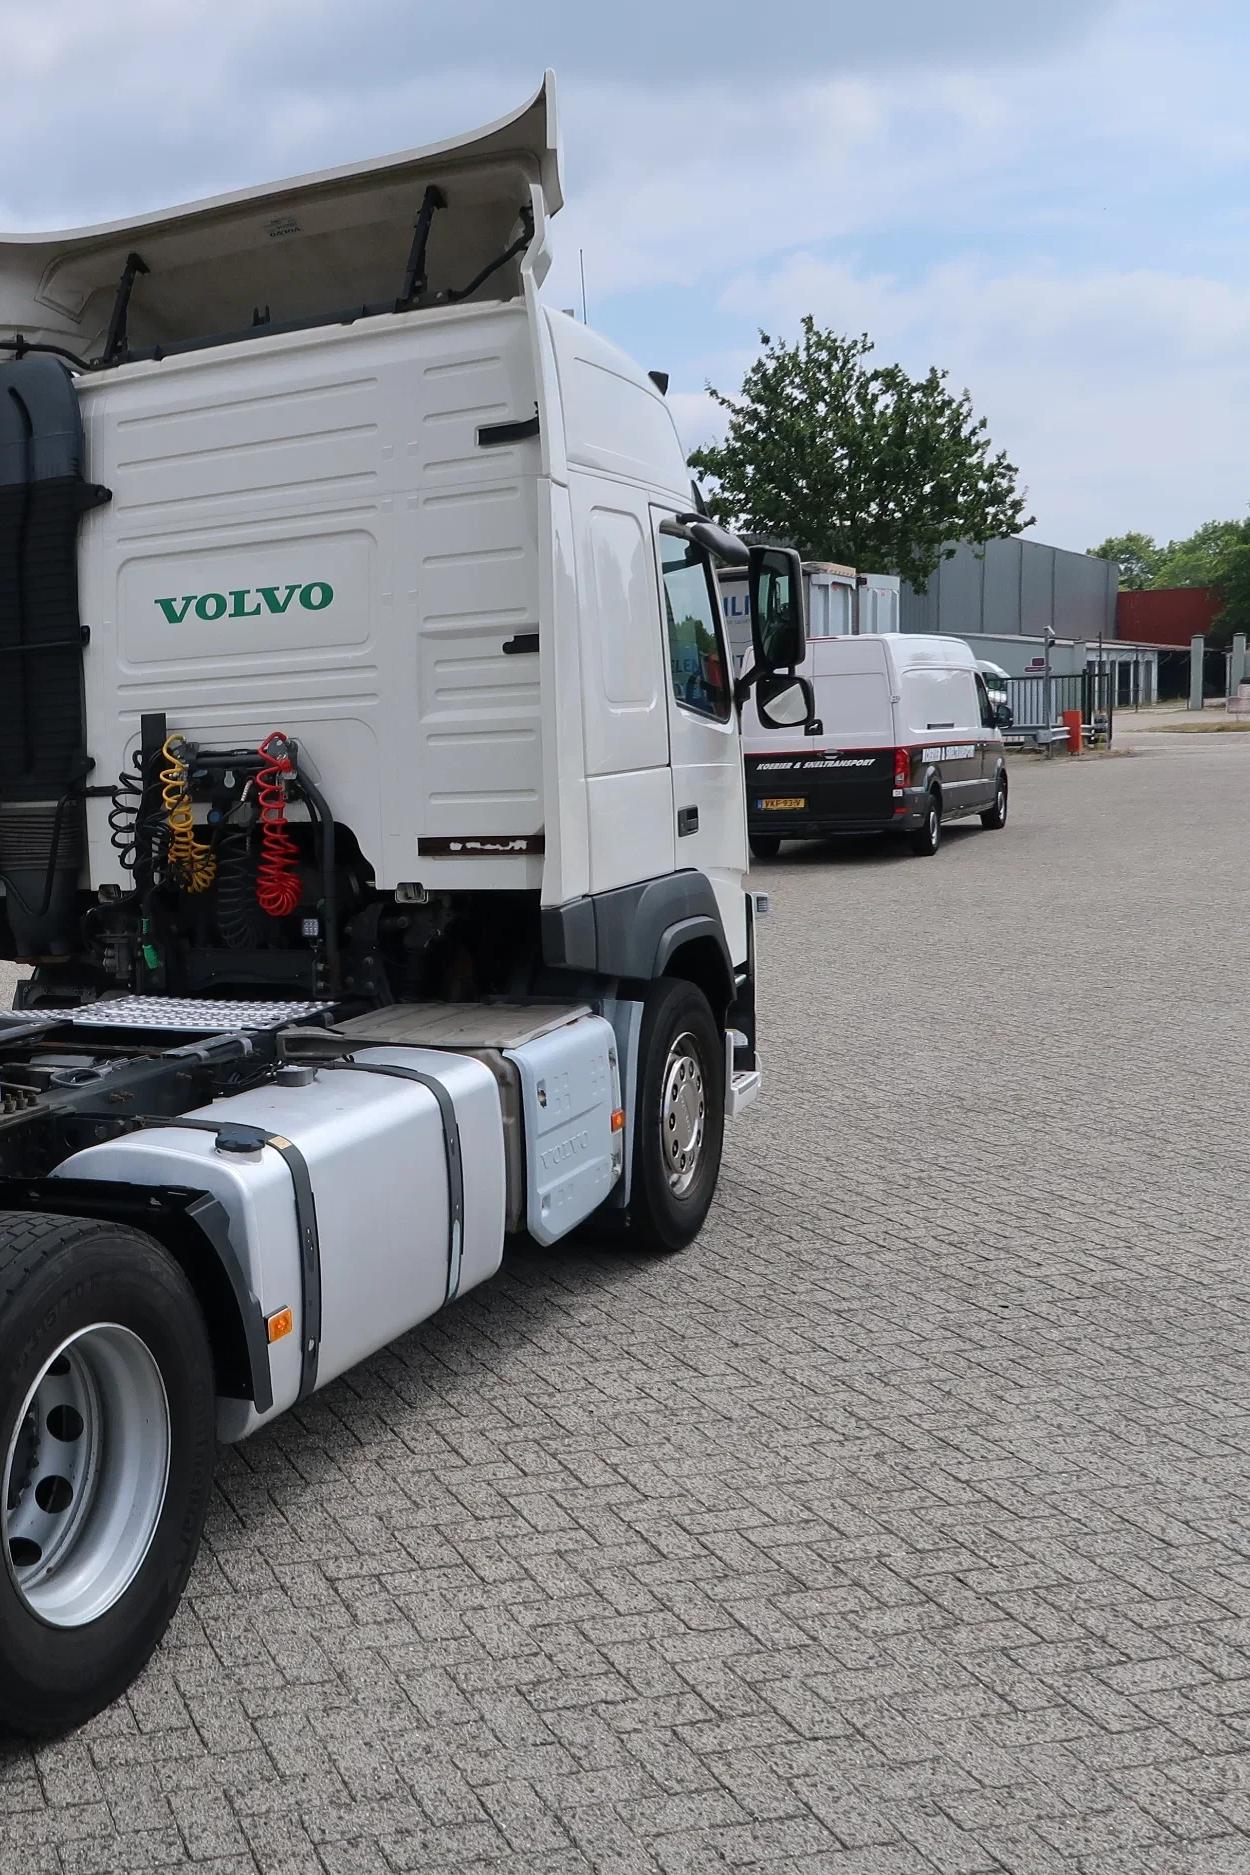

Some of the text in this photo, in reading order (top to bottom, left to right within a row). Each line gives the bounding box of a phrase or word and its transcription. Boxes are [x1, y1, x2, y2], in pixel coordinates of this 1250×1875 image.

[154, 581, 334, 624] VOLVO
[756, 762, 791, 771] KOERIER
[793, 761, 801, 769] &
